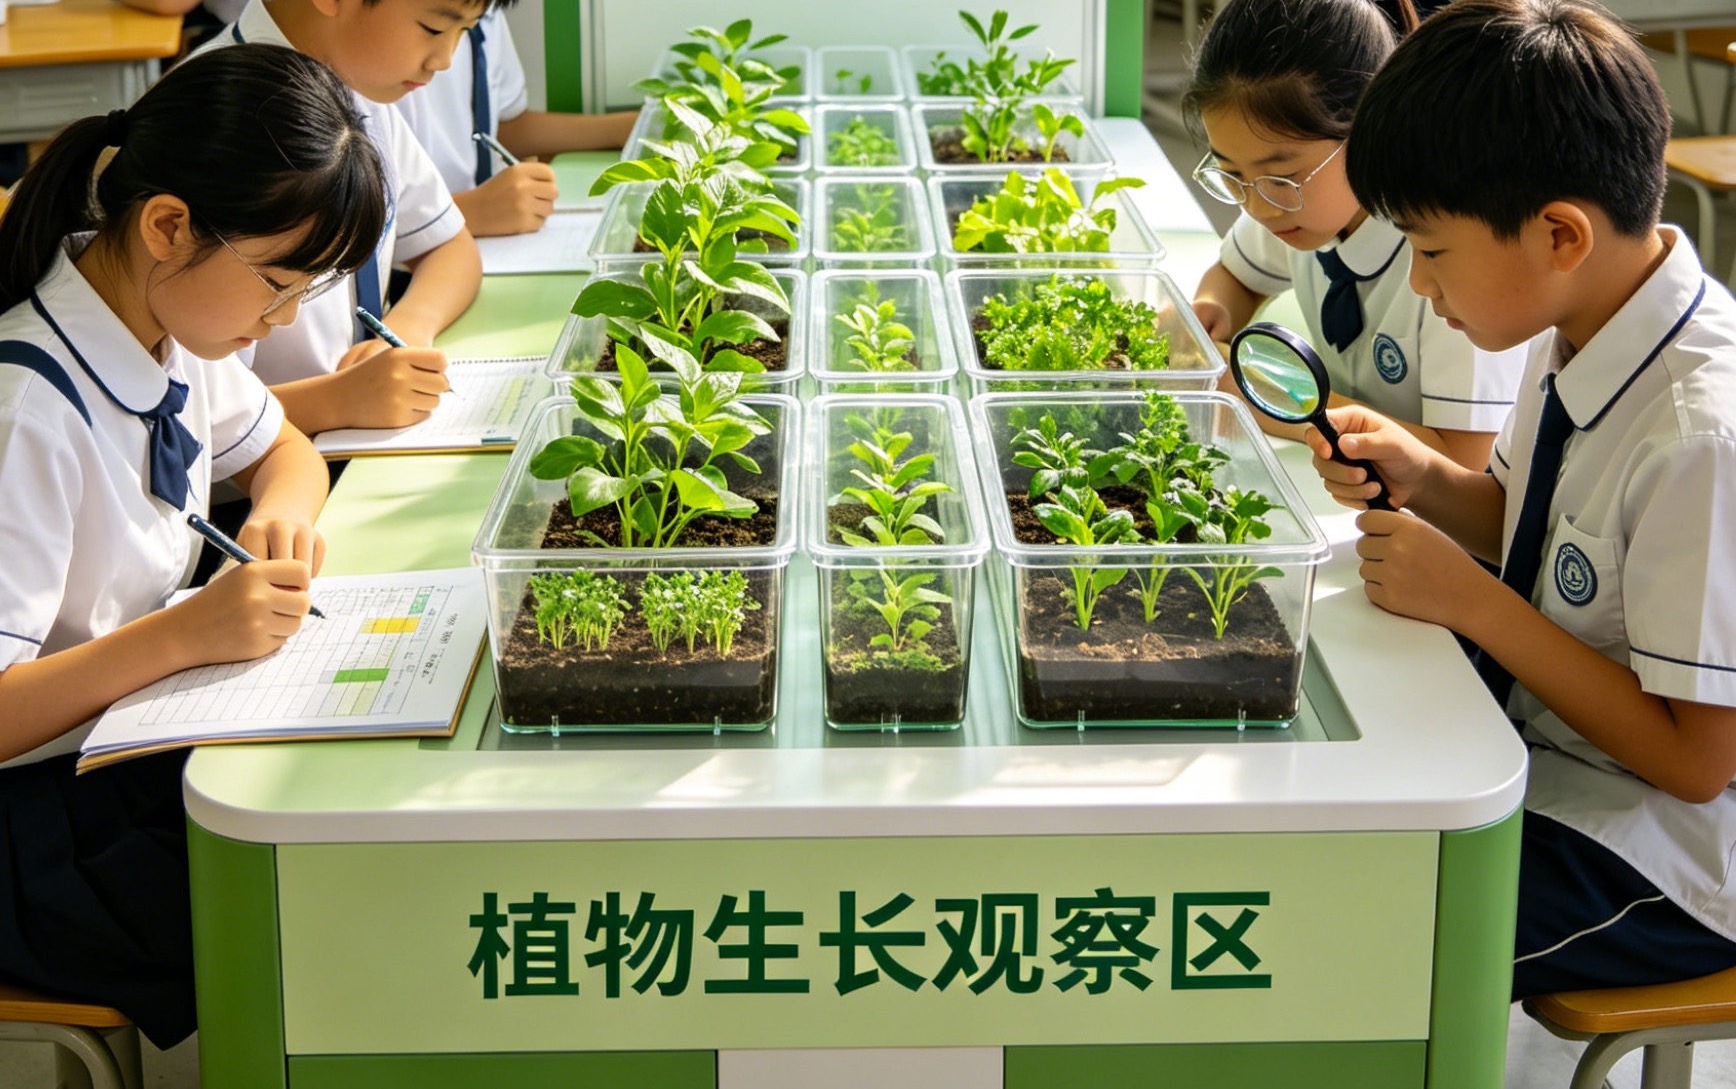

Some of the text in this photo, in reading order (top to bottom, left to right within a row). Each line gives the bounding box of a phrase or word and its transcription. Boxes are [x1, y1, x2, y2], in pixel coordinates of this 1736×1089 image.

[467, 887, 1273, 999] 植物生长观察区
